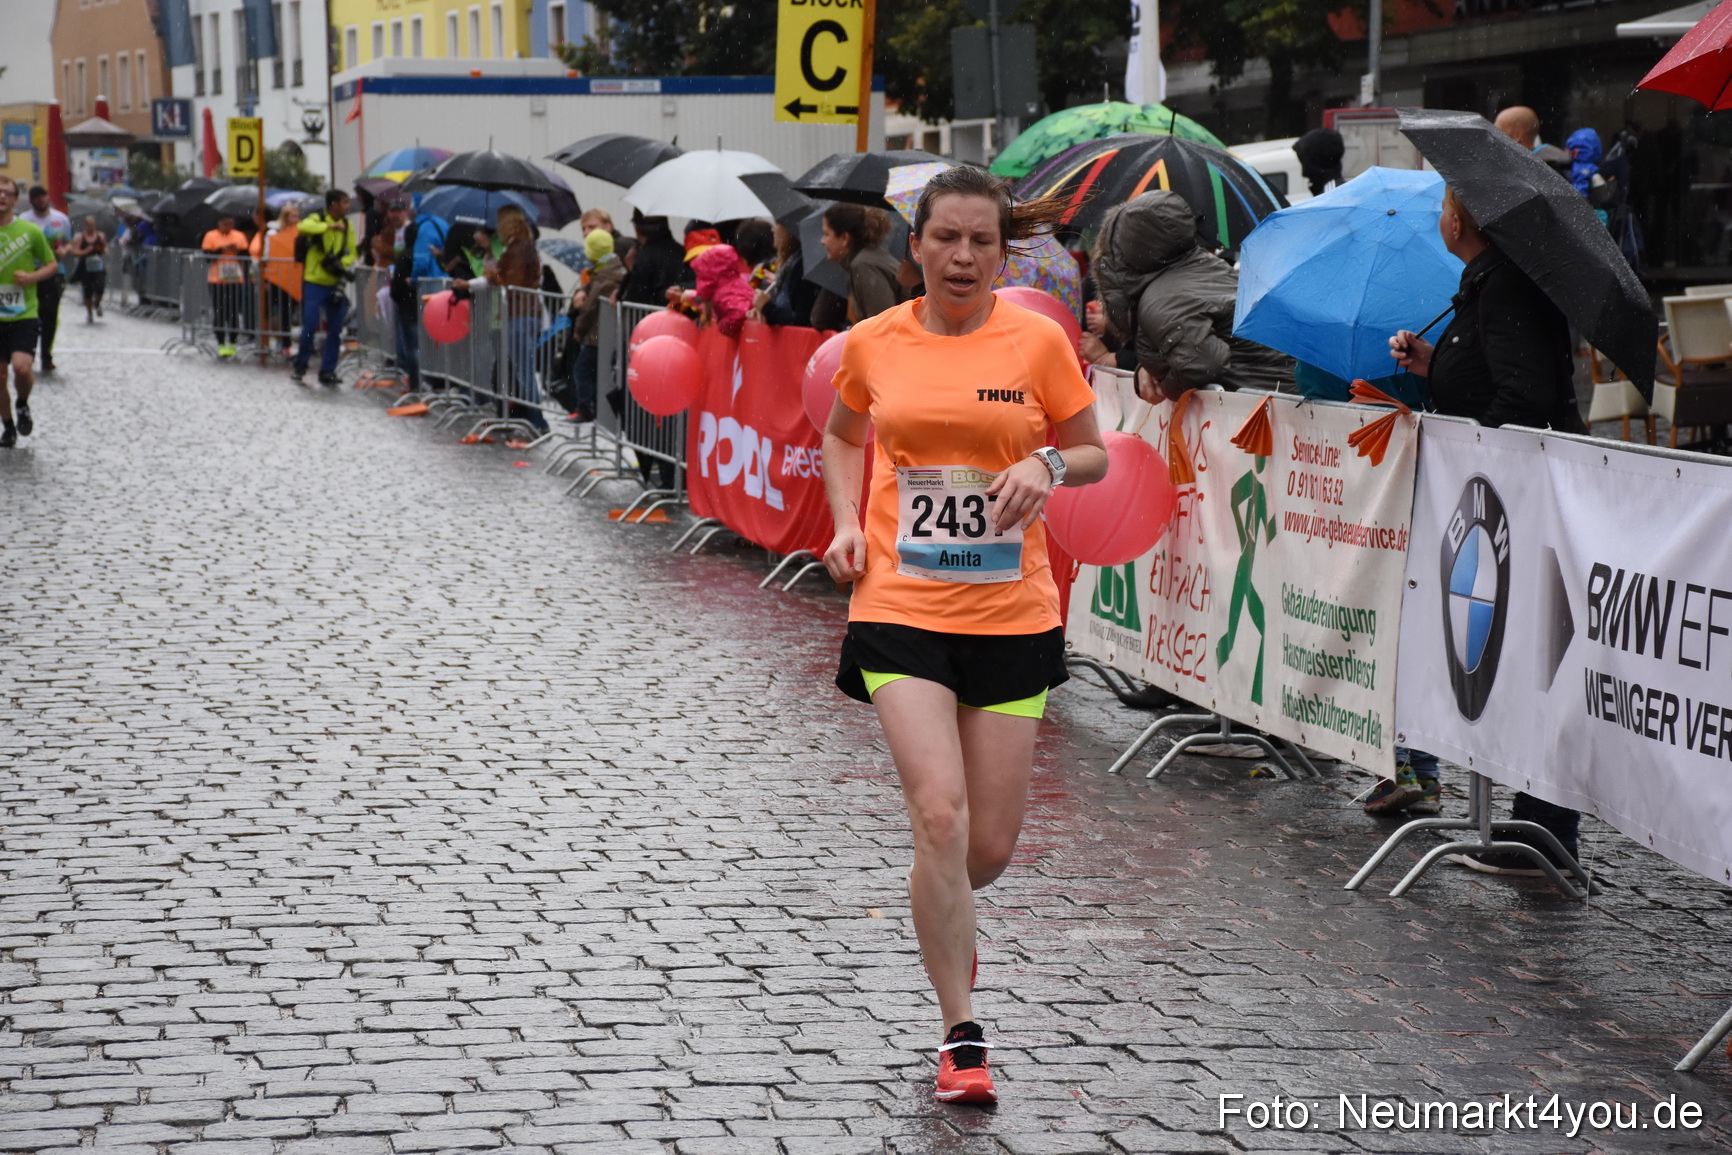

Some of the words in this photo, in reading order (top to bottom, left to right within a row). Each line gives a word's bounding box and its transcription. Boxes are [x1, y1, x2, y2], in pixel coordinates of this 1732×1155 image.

[800, 19, 848, 91] C
[237, 136, 254, 163] D
[976, 389, 1025, 405] THULE
[951, 470, 997, 484] BOC
[1446, 481, 1509, 565] BMW
[938, 549, 982, 567] Anita
[1587, 562, 1677, 661] BMW
[1678, 583, 1732, 672] EF
[1584, 667, 1680, 746] WENIGER
[1685, 697, 1732, 763] VER
